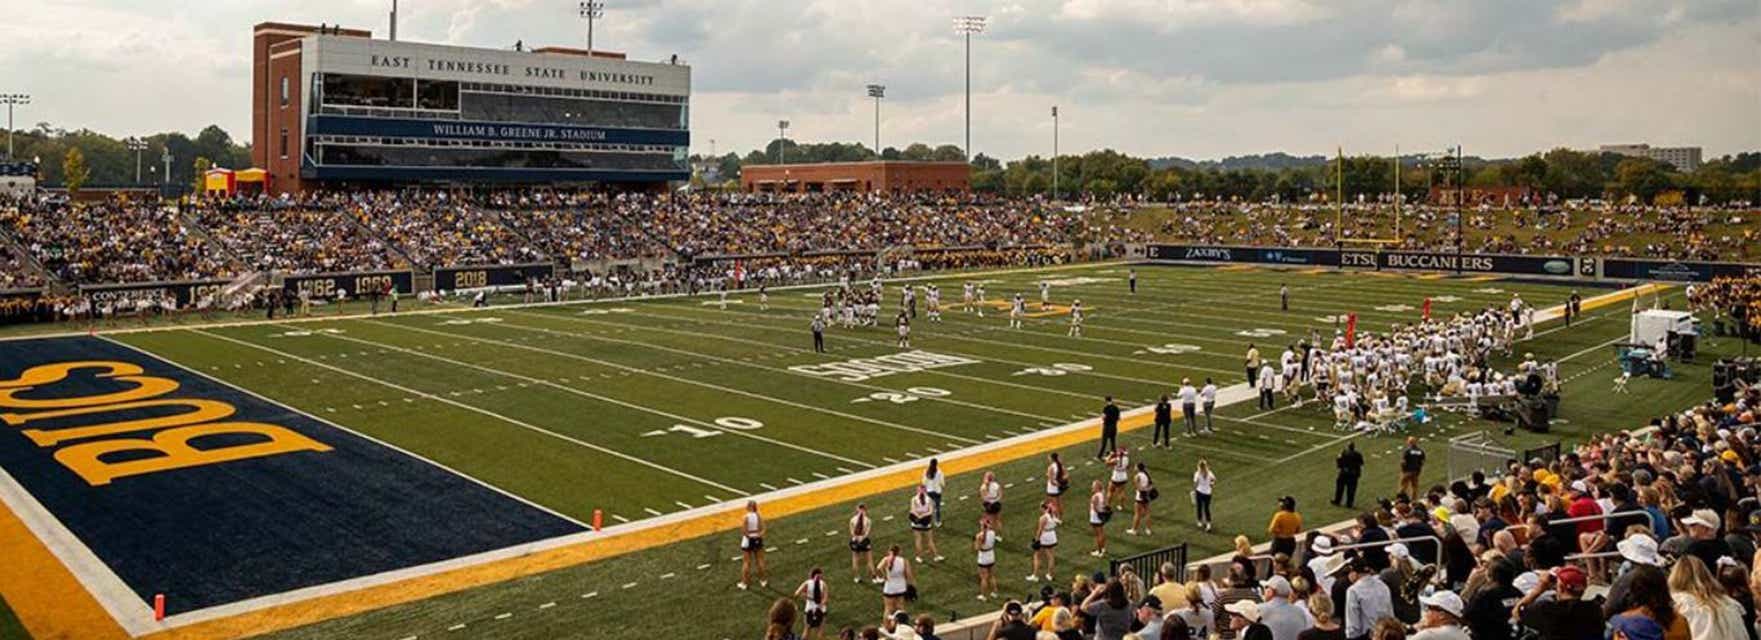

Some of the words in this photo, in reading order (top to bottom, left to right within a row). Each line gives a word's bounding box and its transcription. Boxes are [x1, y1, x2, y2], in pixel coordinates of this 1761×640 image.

[372, 55, 410, 69] EAST
[428, 59, 510, 76] TENNESSEE
[525, 67, 566, 80] STATE
[580, 71, 654, 86] UNIVERSITY
[433, 124, 485, 137] WILLIAM
[488, 126, 498, 137] B.
[501, 126, 541, 138] GREENE
[543, 128, 558, 138] JR.
[561, 129, 606, 140] STADIUM
[455, 271, 487, 288] 2018
[869, 387, 952, 404] 20
[0, 361, 336, 486] BUCS
[668, 416, 764, 438] 10
